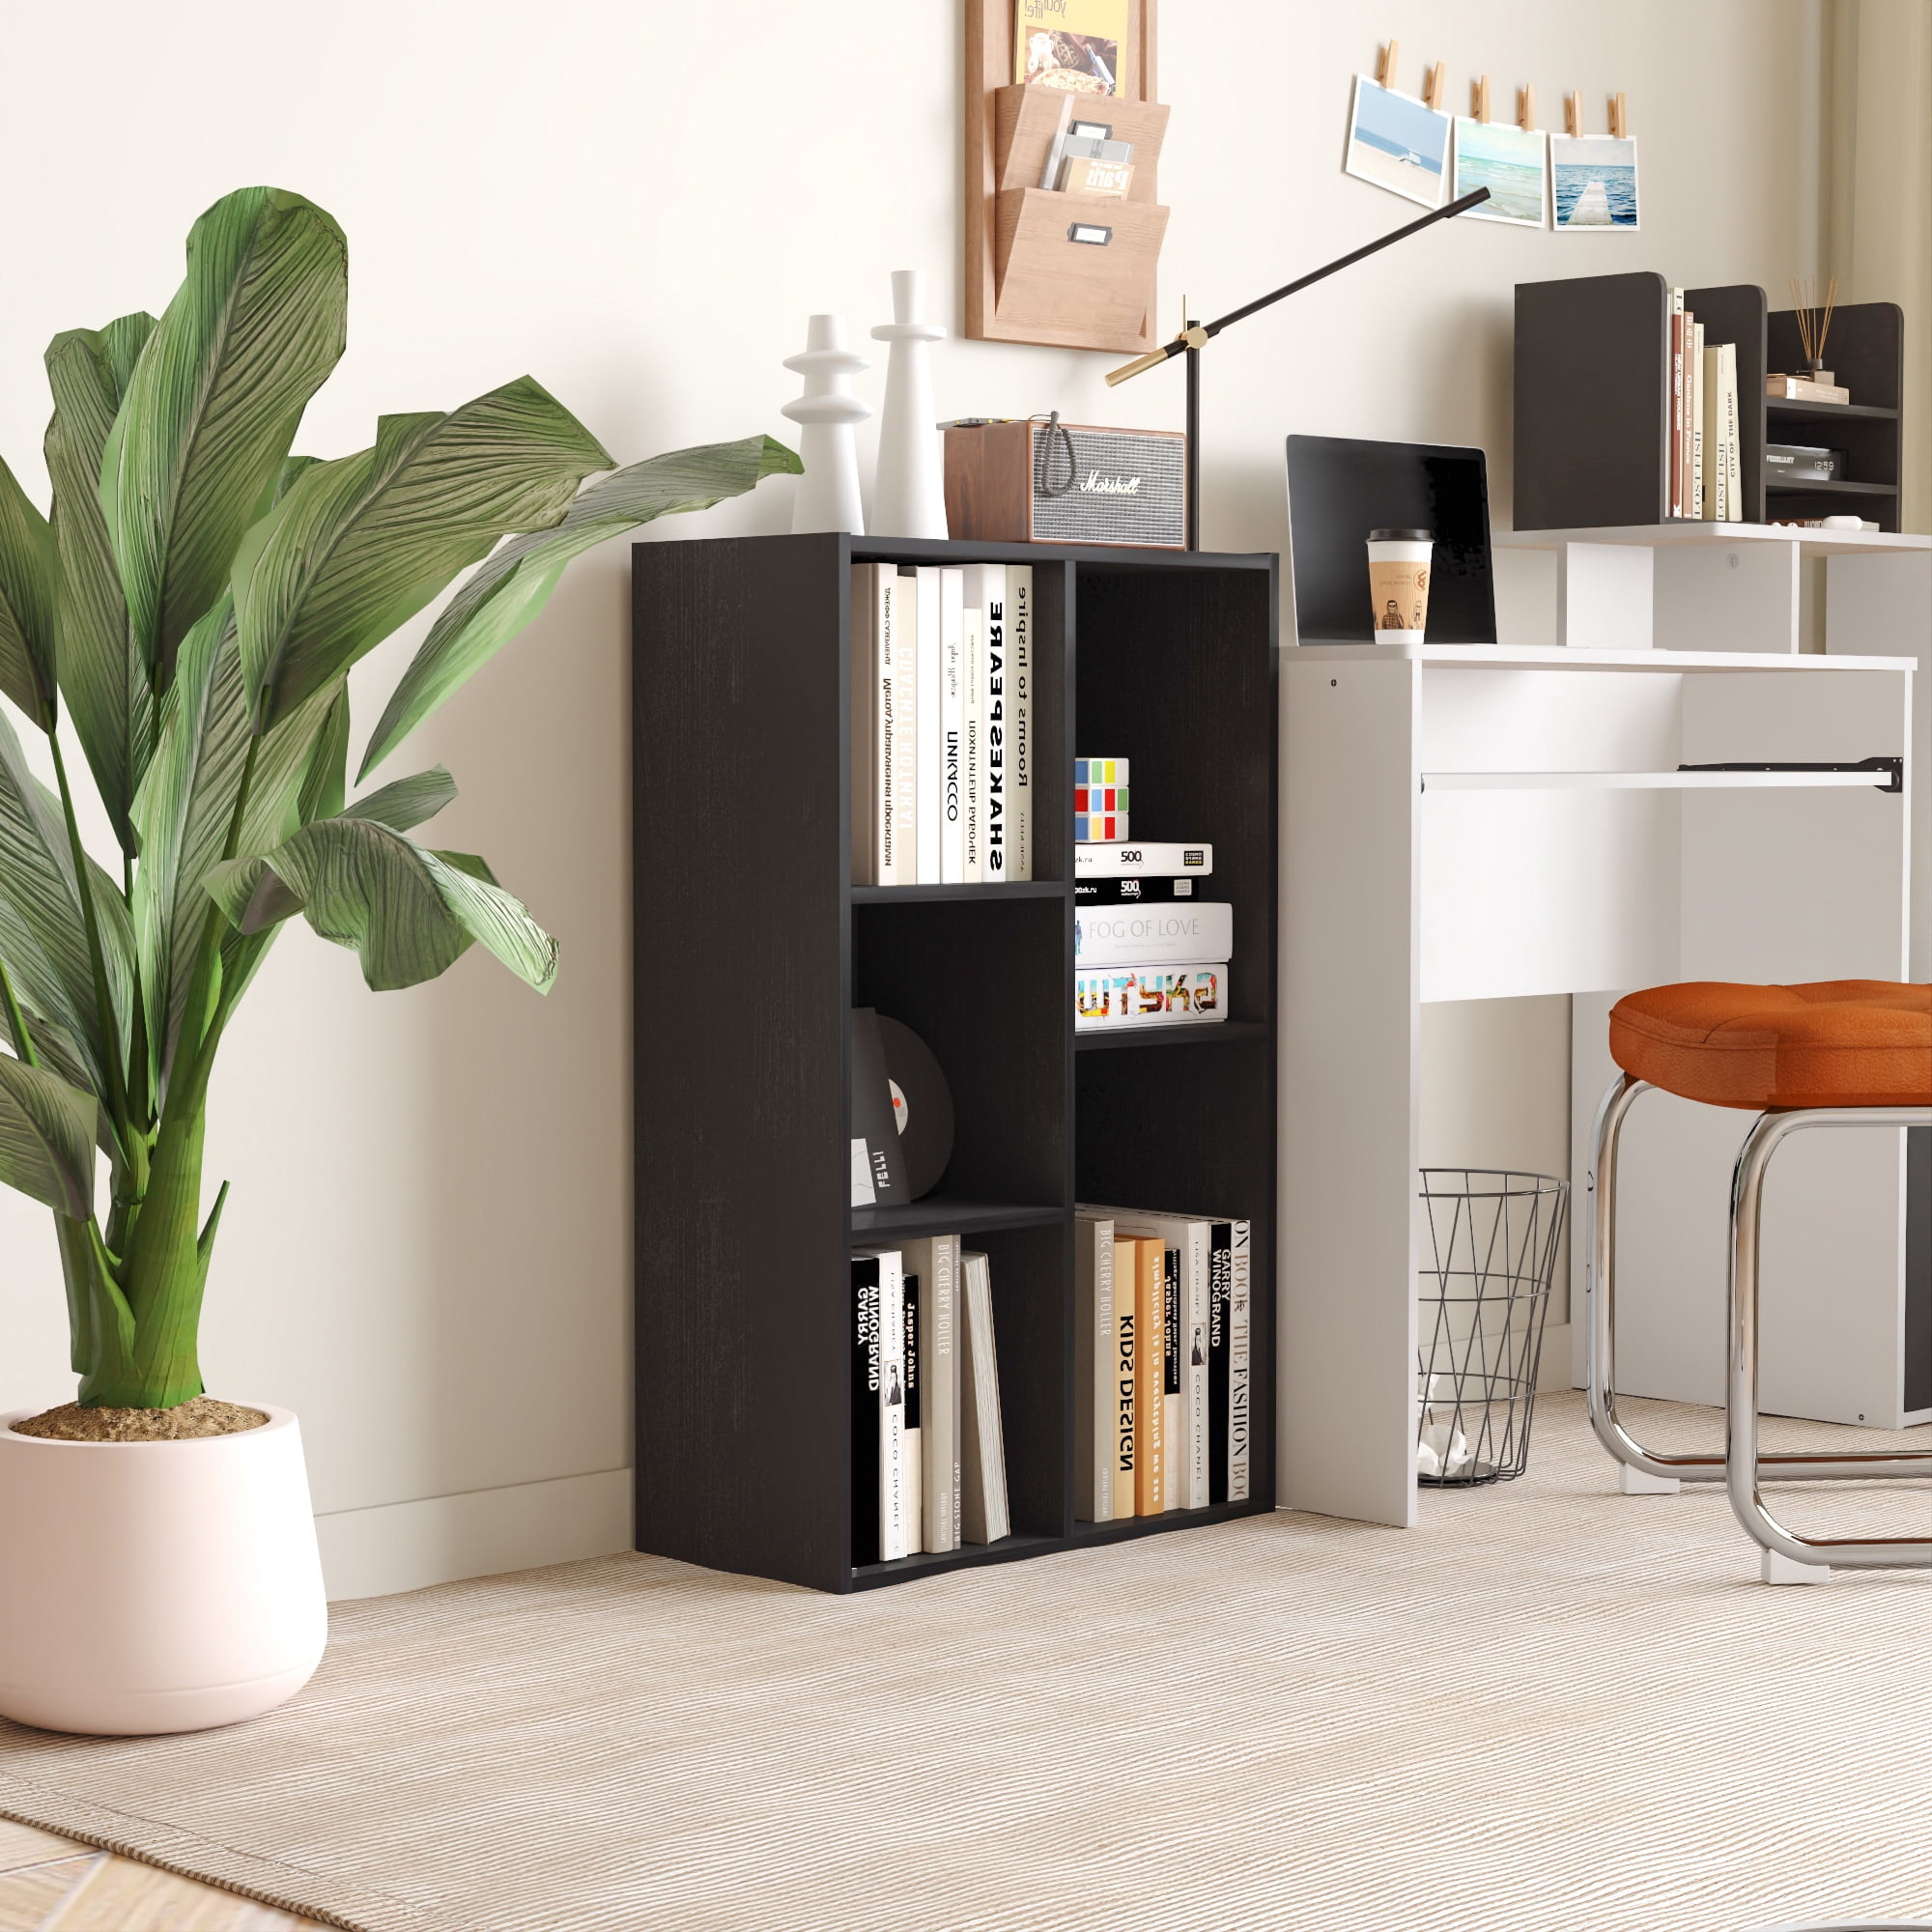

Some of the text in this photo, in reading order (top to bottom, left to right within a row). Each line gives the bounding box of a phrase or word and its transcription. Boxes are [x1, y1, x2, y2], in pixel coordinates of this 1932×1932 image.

[1686, 418, 1691, 427] in
[1729, 441, 1734, 454] OF
[1080, 469, 1141, 494] Marshall
[1121, 850, 1143, 863] 500
[1121, 880, 1140, 893] 500
[1090, 918, 1201, 939] FOG OF LOVE
[872, 1151, 891, 1188] FELLI
[1235, 1220, 1250, 1249] ON
[1099, 1230, 1112, 1336] BIG CHERRY HOLLER
[1221, 1249, 1231, 1301] GARRY
[937, 1244, 951, 1354] BIG CHERRY HOLLER
[1211, 1249, 1222, 1348] WINOGRAND
[905, 1302, 916, 1389] Jasper Johns
[1234, 1320, 1249, 1365] THE
[1233, 1368, 1248, 1457] FASHION
